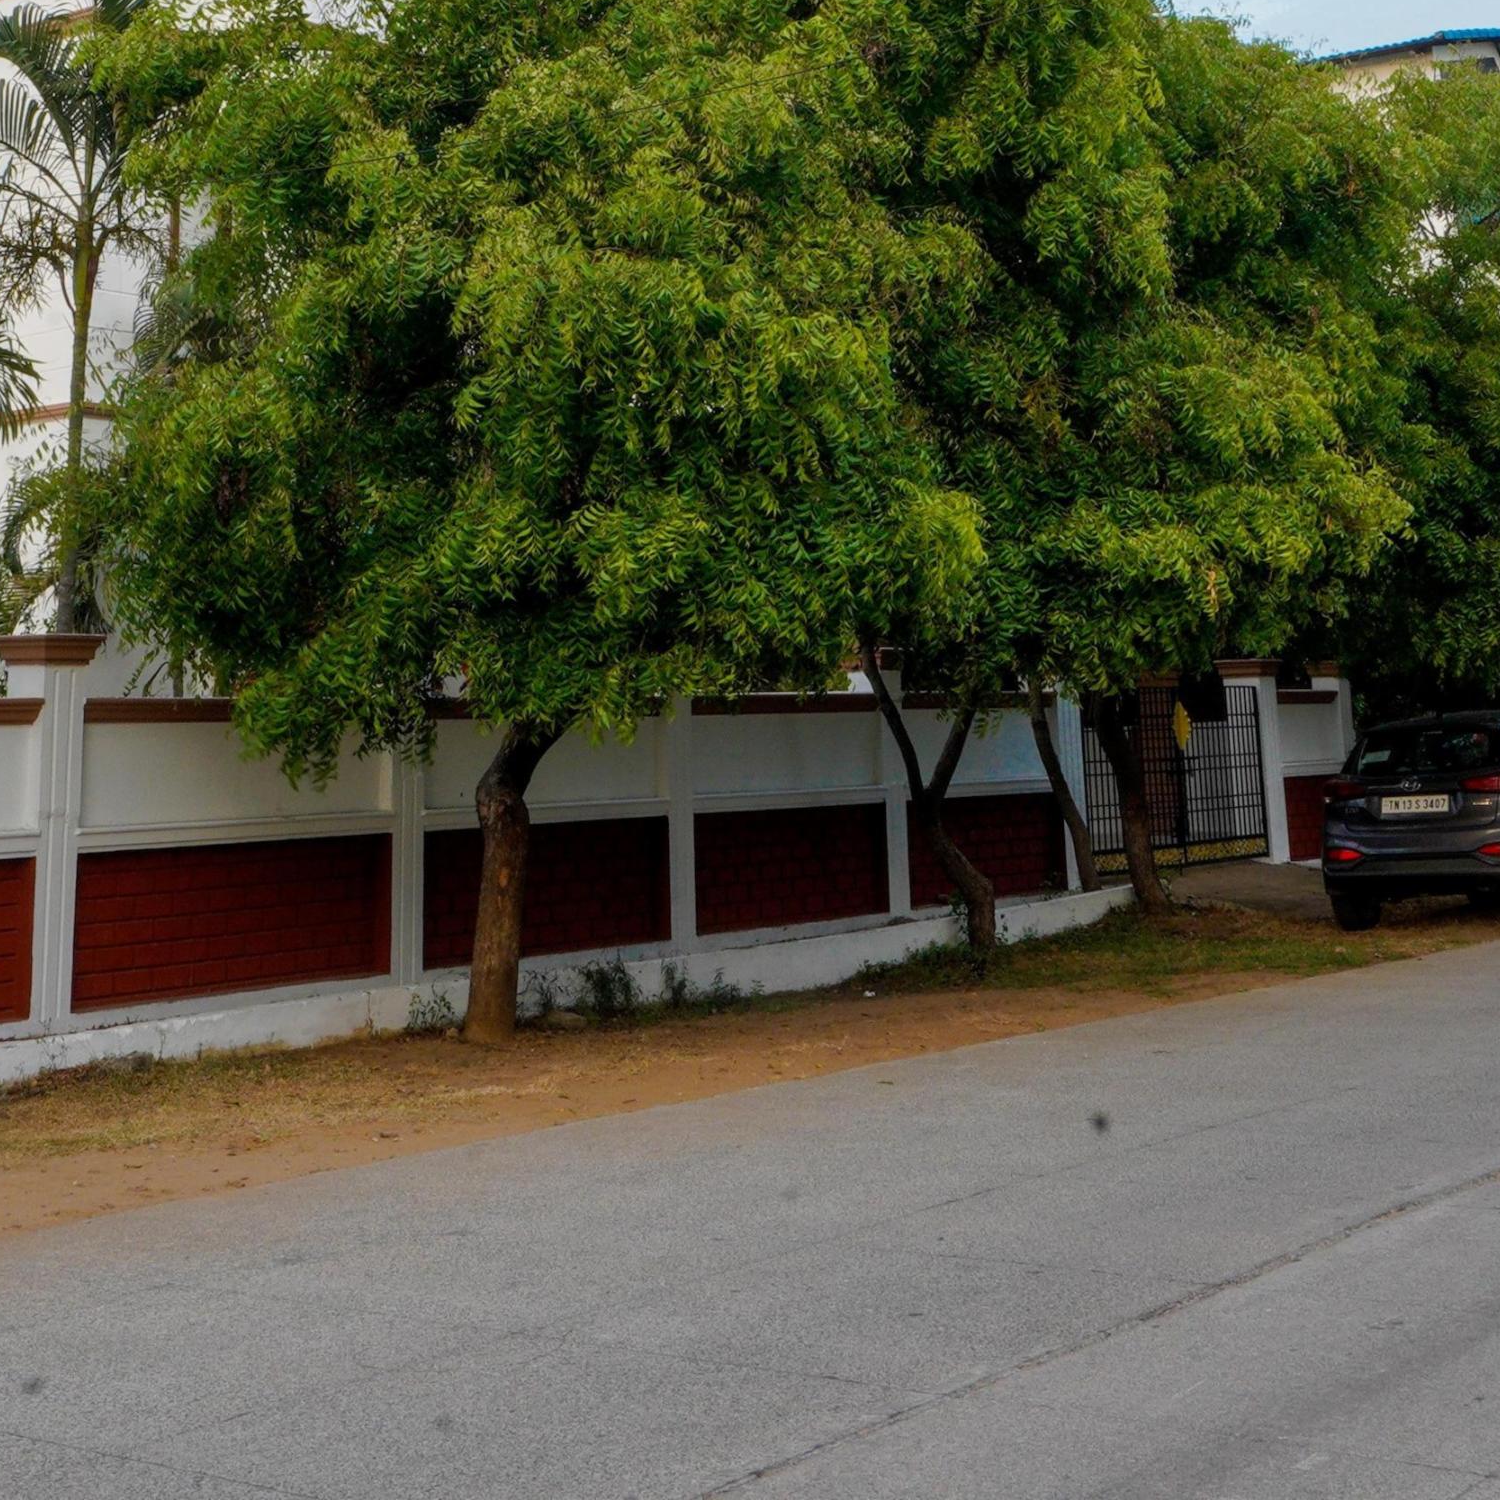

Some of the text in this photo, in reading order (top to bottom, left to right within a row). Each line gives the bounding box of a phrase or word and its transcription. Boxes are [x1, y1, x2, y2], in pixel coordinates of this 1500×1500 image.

[1389, 798, 1446, 810] TN 13 S 3407
